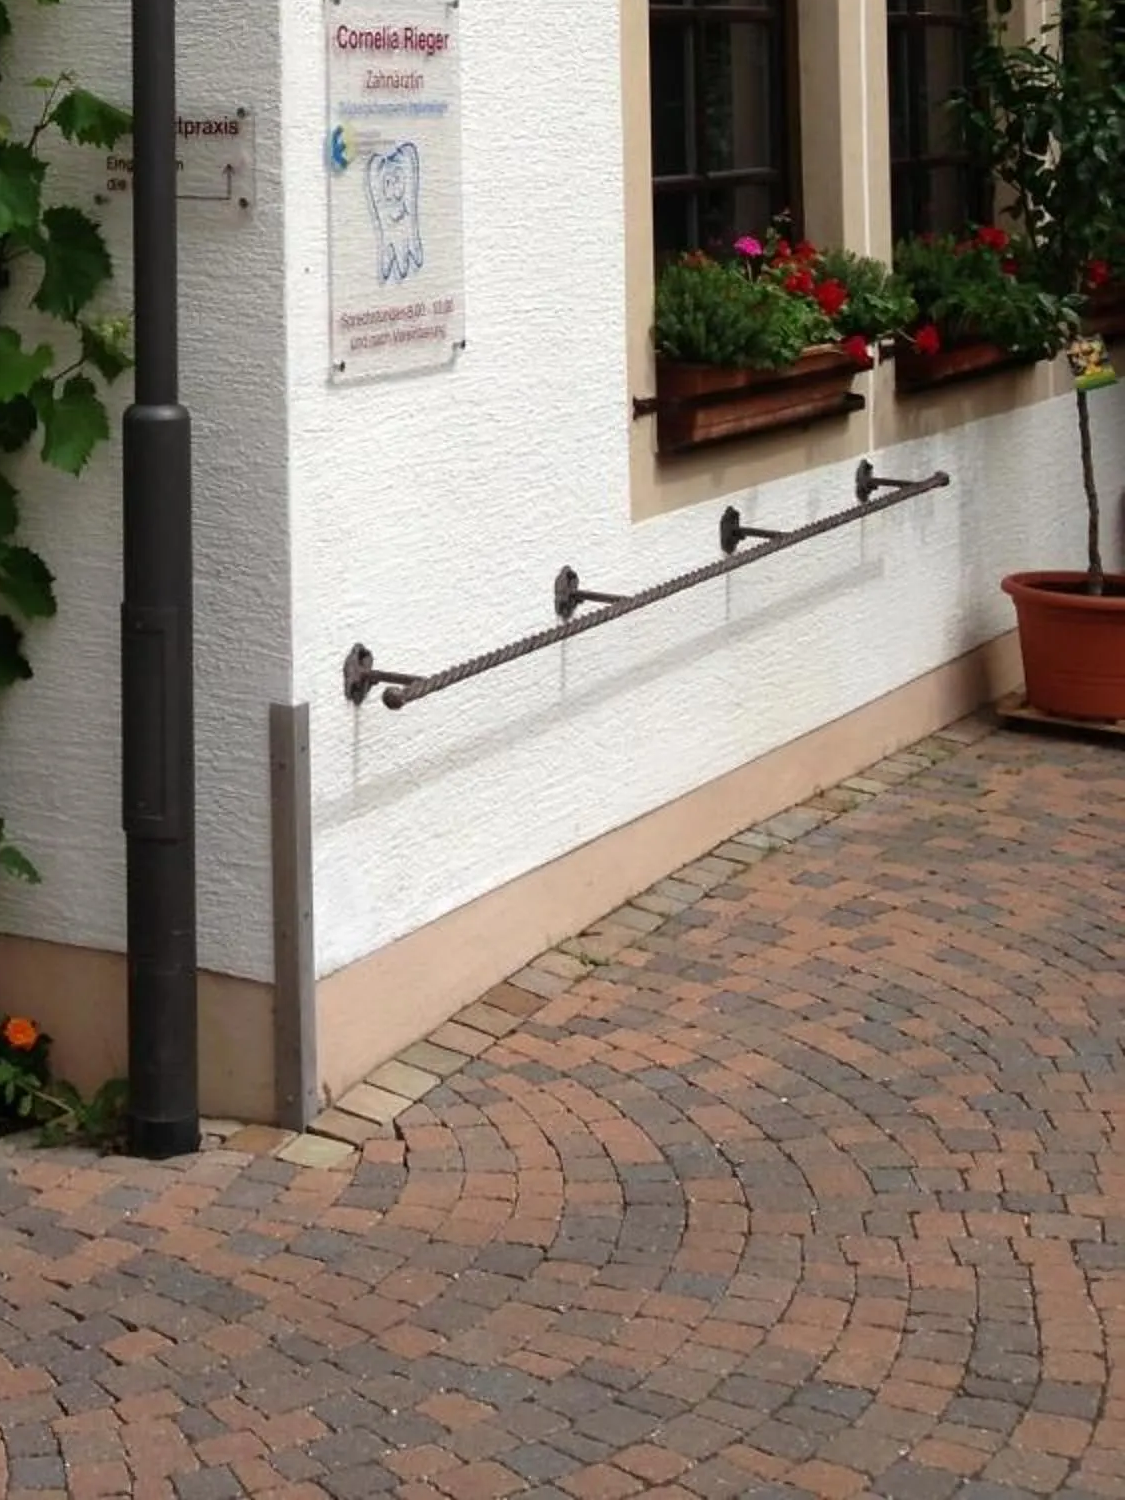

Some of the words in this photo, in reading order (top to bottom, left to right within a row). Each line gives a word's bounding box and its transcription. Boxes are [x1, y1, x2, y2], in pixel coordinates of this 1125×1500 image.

[336, 24, 399, 50] Cornelia
[403, 26, 450, 57] Rieger
[177, 115, 239, 139] tpraxis
